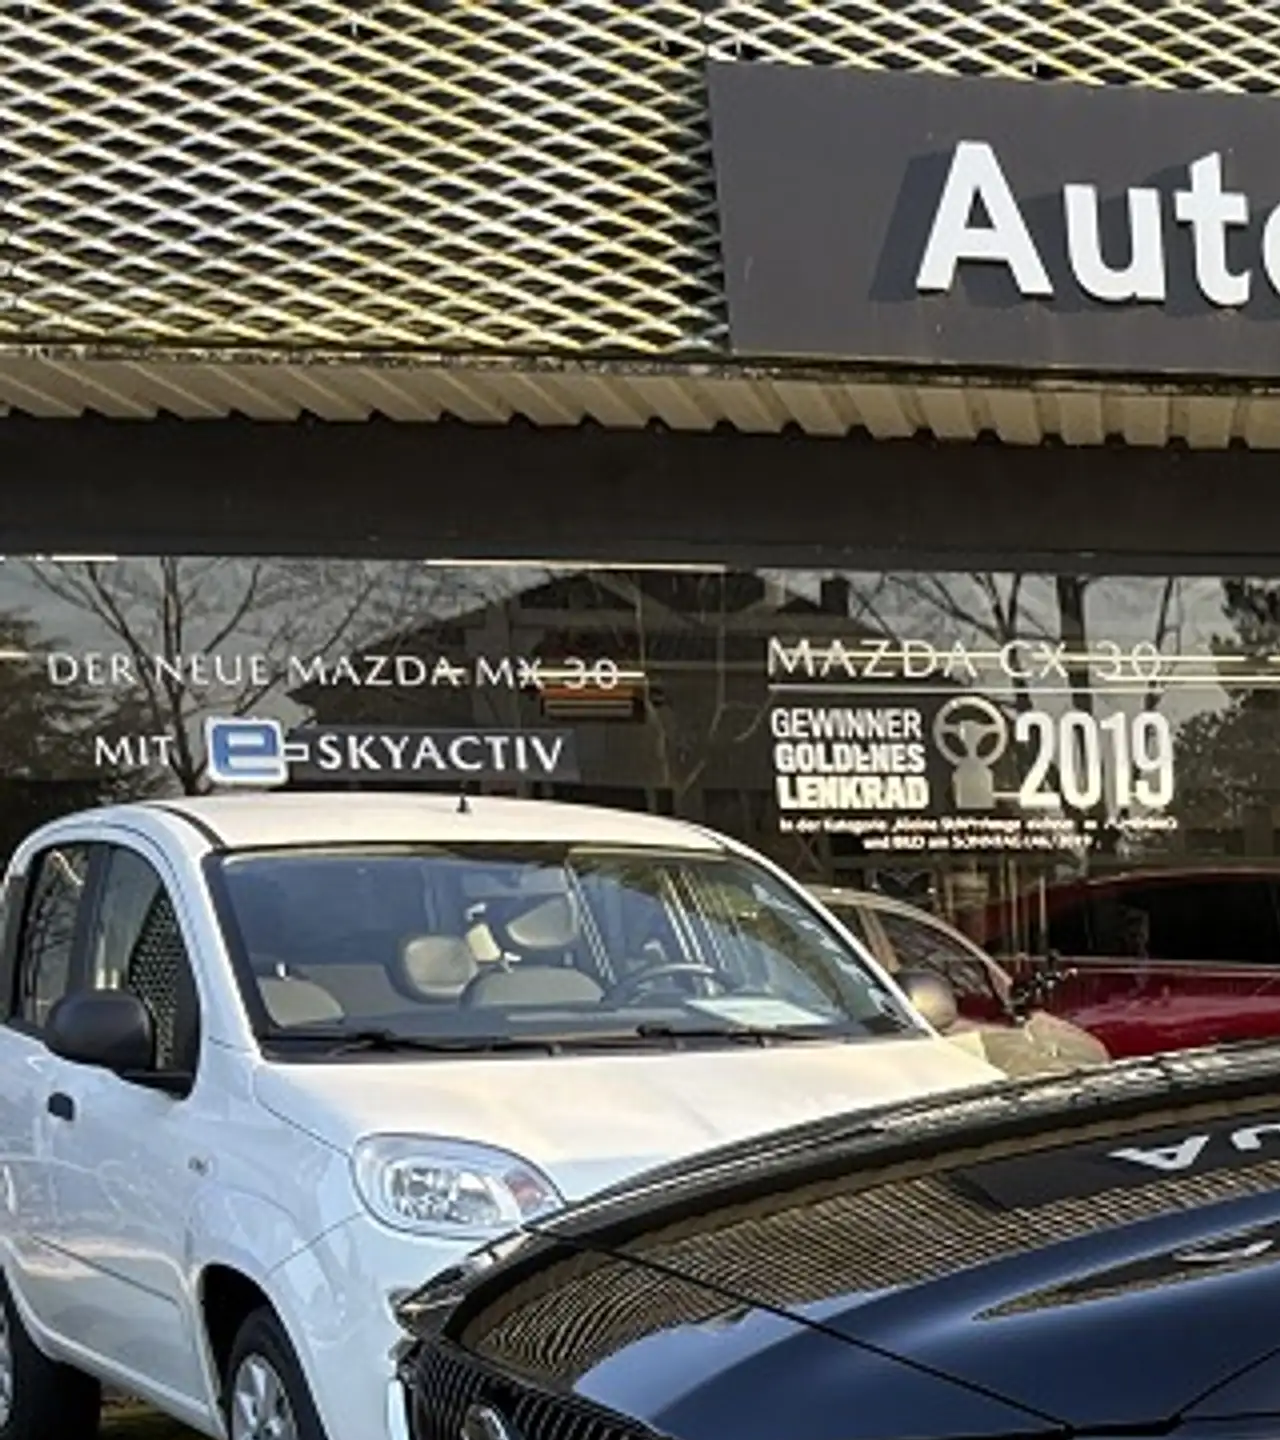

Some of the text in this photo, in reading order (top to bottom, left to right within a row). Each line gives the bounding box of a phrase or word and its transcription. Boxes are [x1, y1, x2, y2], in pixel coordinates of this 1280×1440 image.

[48, 653, 135, 686] DER
[155, 653, 274, 687] NEUE
[288, 654, 466, 688] MAZDA
[476, 656, 544, 689] MX
[768, 638, 978, 678] MAZDA
[1000, 639, 1068, 678] CX
[771, 707, 922, 738] GEWINNER
[95, 736, 174, 766] MIT
[775, 741, 926, 773] GOLDENES
[1015, 711, 1175, 810] 2019
[776, 775, 930, 810] LENKRAD
